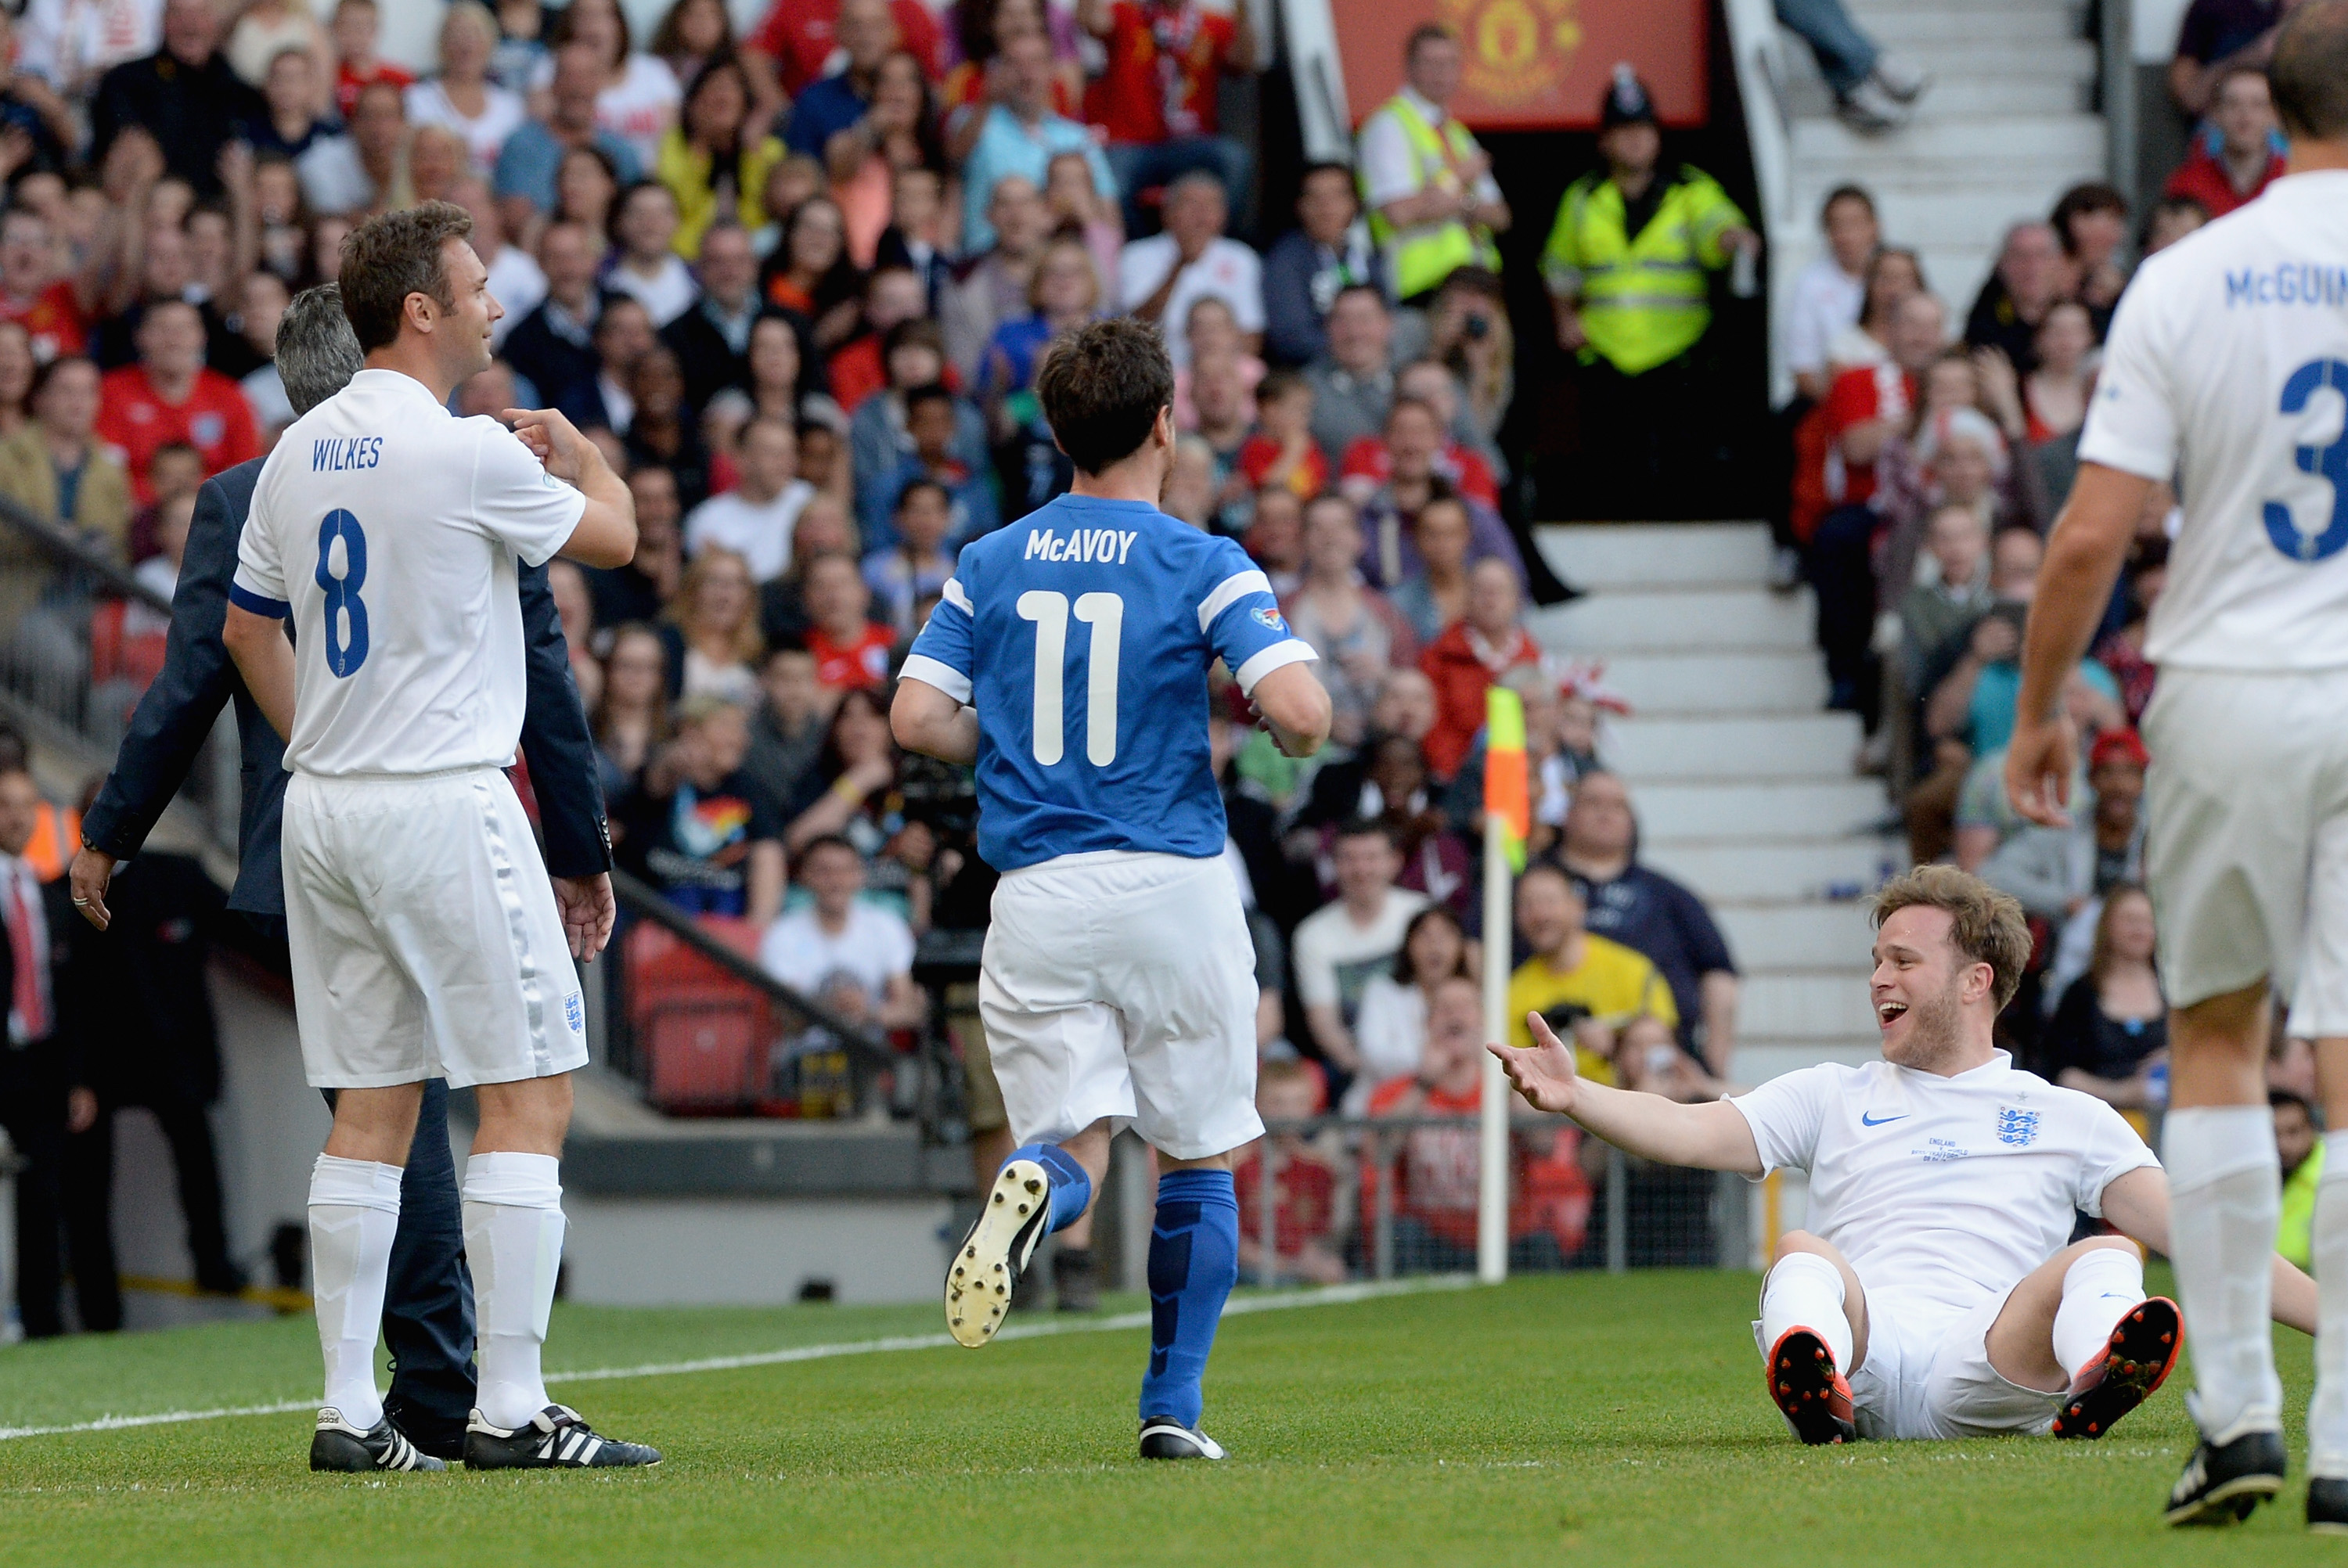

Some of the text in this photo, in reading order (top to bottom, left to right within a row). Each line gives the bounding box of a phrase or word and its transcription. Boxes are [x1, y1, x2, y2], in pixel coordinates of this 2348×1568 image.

[312, 437, 383, 472] WILKES
[2263, 358, 2348, 563] 3
[315, 508, 369, 679] 8
[1024, 528, 1137, 565] McAVOY
[1016, 590, 1124, 767] 11
[1928, 1138, 1956, 1147] ENGLAND
